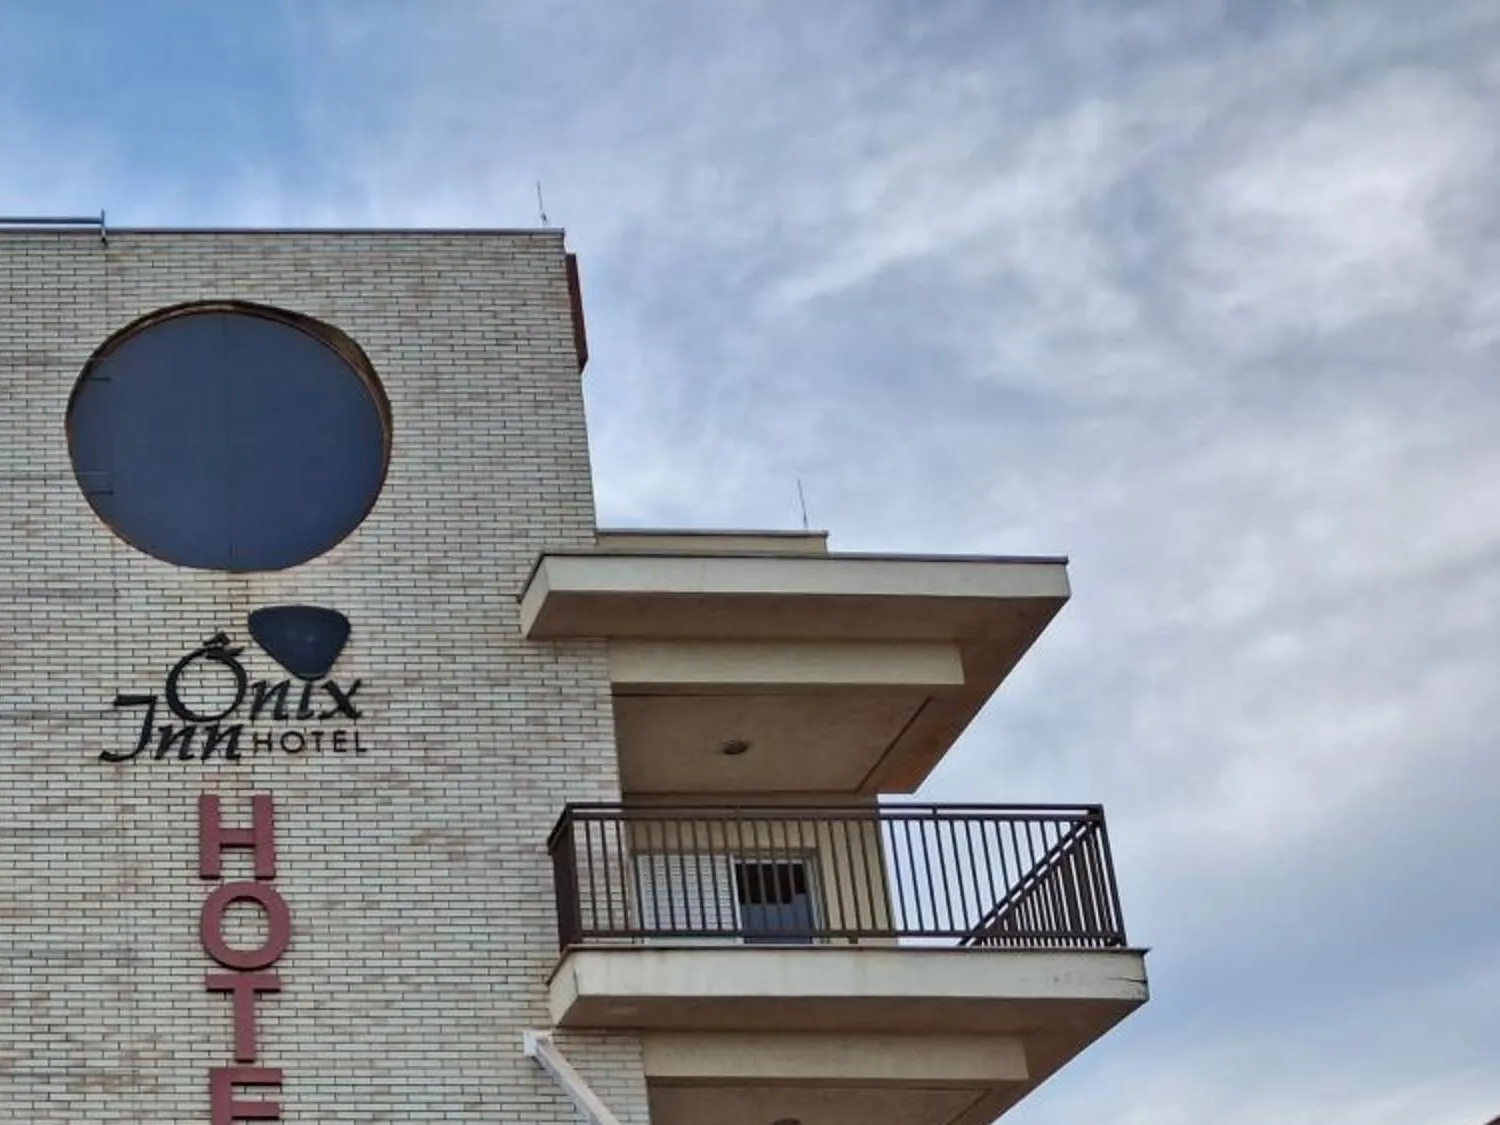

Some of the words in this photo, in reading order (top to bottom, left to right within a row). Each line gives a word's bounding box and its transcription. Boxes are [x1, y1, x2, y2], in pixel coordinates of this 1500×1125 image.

[165, 631, 363, 722] Ônix
[99, 694, 245, 763] Inn
[253, 730, 369, 754] HOTEL
